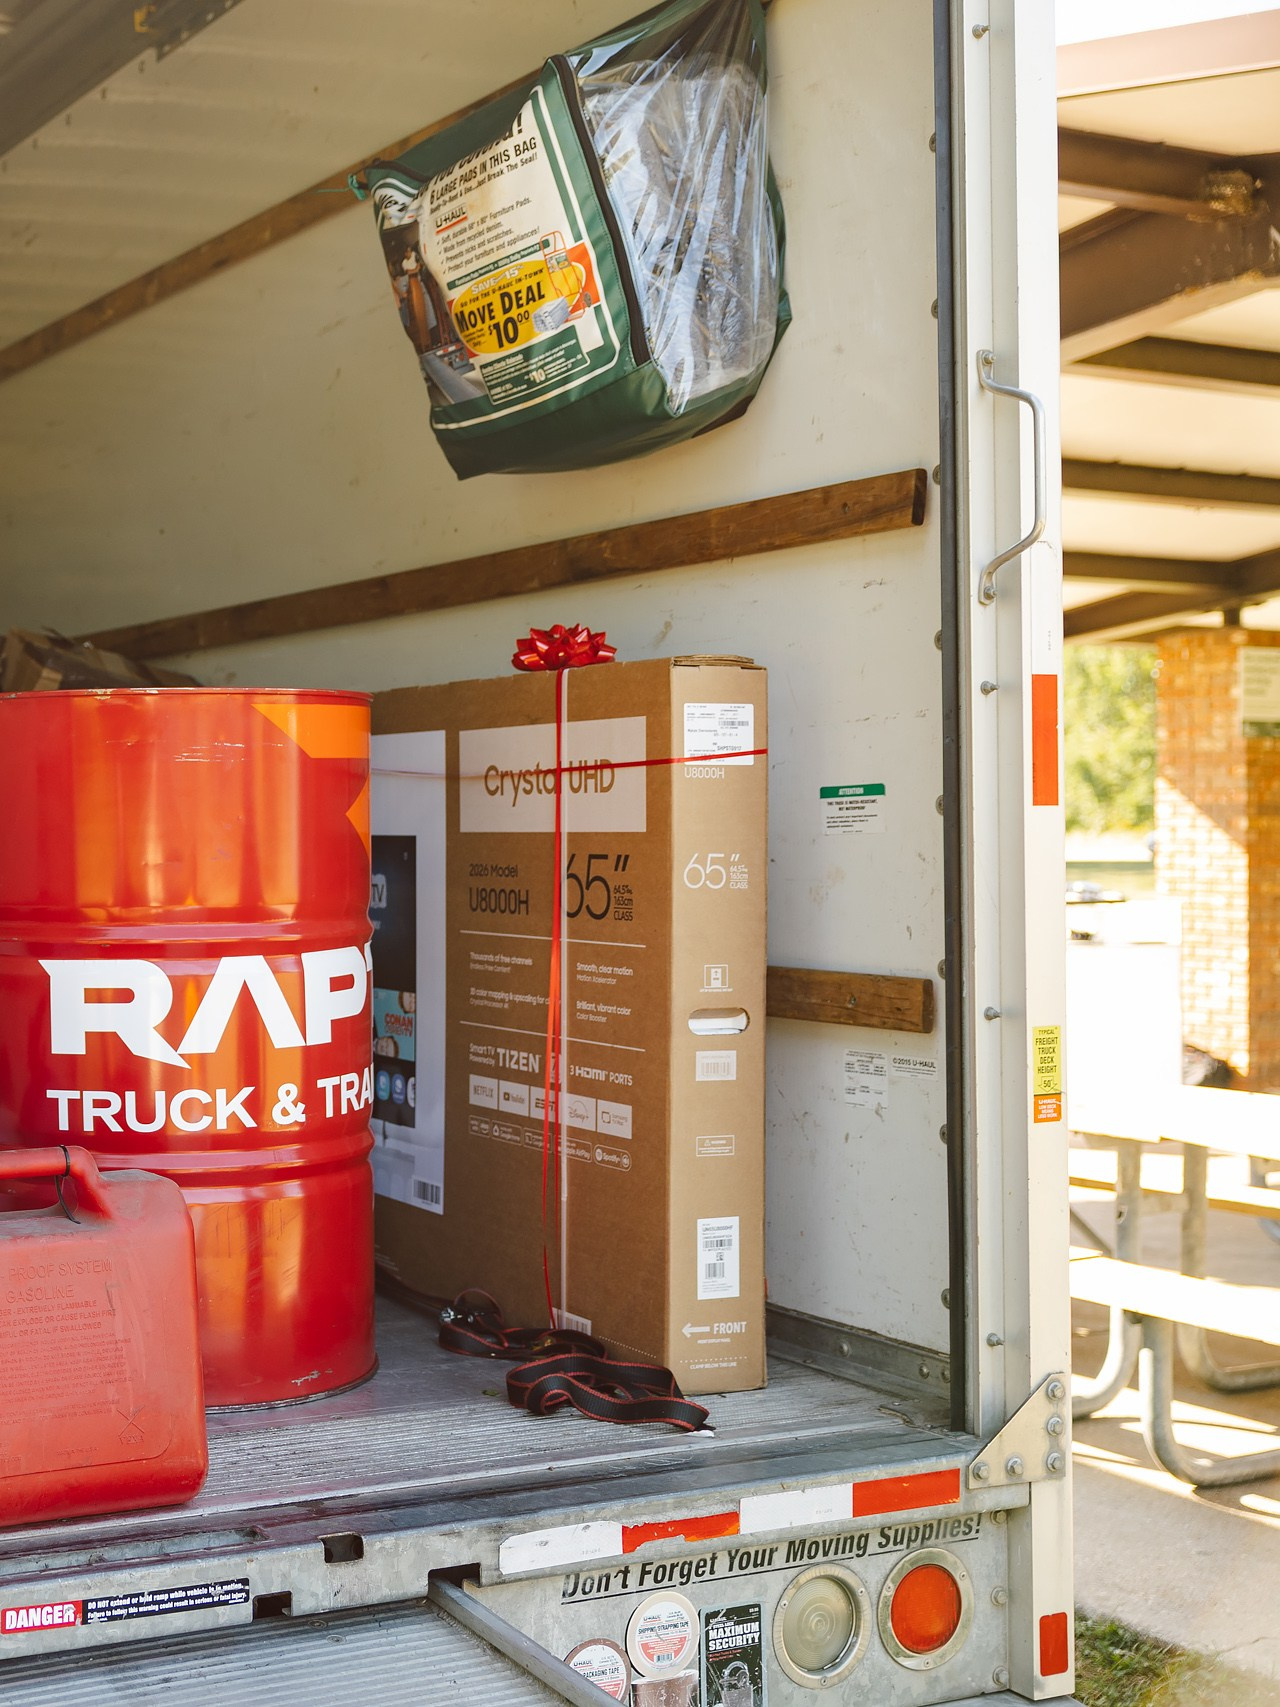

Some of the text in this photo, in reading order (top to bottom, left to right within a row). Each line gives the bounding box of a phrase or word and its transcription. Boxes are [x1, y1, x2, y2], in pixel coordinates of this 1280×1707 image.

[520, 152, 538, 167] Seal!
[436, 136, 537, 200] LARGE PADS IN THIS BAG
[455, 281, 545, 333] MOVE DEAL
[684, 767, 725, 779] U8000H
[484, 759, 615, 807] Crysta UHD
[470, 863, 488, 877] 2026
[490, 864, 518, 878] Model
[729, 881, 749, 889] CLASS
[469, 887, 529, 915] U8000H
[614, 910, 633, 921] CLASS
[470, 952, 533, 966] Thousands free channels
[576, 962, 633, 976] Smooth, clear motion
[576, 974, 592, 982] Motion
[488, 990, 509, 1001] mapping
[513, 993, 536, 1006] upscaling
[537, 996, 545, 1004] for
[576, 1001, 631, 1016] Brilliant, vibrant color
[576, 1012, 607, 1023] Color Booster
[1035, 1037, 1058, 1046] FREIGHT
[1038, 1046, 1056, 1055] TRUCK
[470, 1043, 539, 1074] Smart TV TIZEN
[470, 1054, 489, 1066] Powered
[1040, 1056, 1054, 1064] DECK
[570, 1065, 575, 1076] 3
[609, 1071, 633, 1086] PORTS
[1037, 1065, 1057, 1074] HEIGHT
[473, 1085, 494, 1099] NETFLIX
[46, 1086, 257, 1133] TRUCK
[271, 1083, 306, 1125] &
[603, 1151, 618, 1163] Spotify
[9, 1264, 54, 1281] PROOF
[58, 1258, 113, 1277] SYSTEM
[5, 1285, 75, 1304] GASOLINE
[17, 1303, 55, 1315] EXTREMELY
[57, 1300, 97, 1311] FLAMMABLE
[12, 1316, 43, 1327] EXPLODE
[44, 1315, 55, 1323] OR
[56, 1312, 78, 1322] CAUSE
[79, 1310, 100, 1320] FLASH
[101, 1308, 116, 1317] FIRE
[19, 1329, 29, 1337] OR
[30, 1326, 52, 1336] FATAL
[60, 1321, 102, 1333] SWALLOWED
[713, 1321, 747, 1335] FRONT
[562, 1512, 982, 1599] Don't Forget Your Moving Supplies!
[97, 1600, 109, 1608] NOT
[110, 1597, 131, 1607] extend
[154, 1593, 169, 1602] ramp
[170, 1590, 186, 1599] while
[187, 1588, 208, 1597] vehicle
[222, 1582, 244, 1591] motion.
[5, 1604, 75, 1630] DANGER
[88, 1610, 105, 1619] Failure
[128, 1605, 138, 1613] this
[139, 1603, 159, 1613] warning
[160, 1601, 173, 1610] could
[174, 1600, 188, 1608] result
[195, 1596, 213, 1605] serious
[231, 1592, 247, 1601] injury.
[709, 1622, 759, 1640] MAXIMUM
[709, 1632, 760, 1651] SECURITY
[609, 1667, 620, 1675] TAPE
